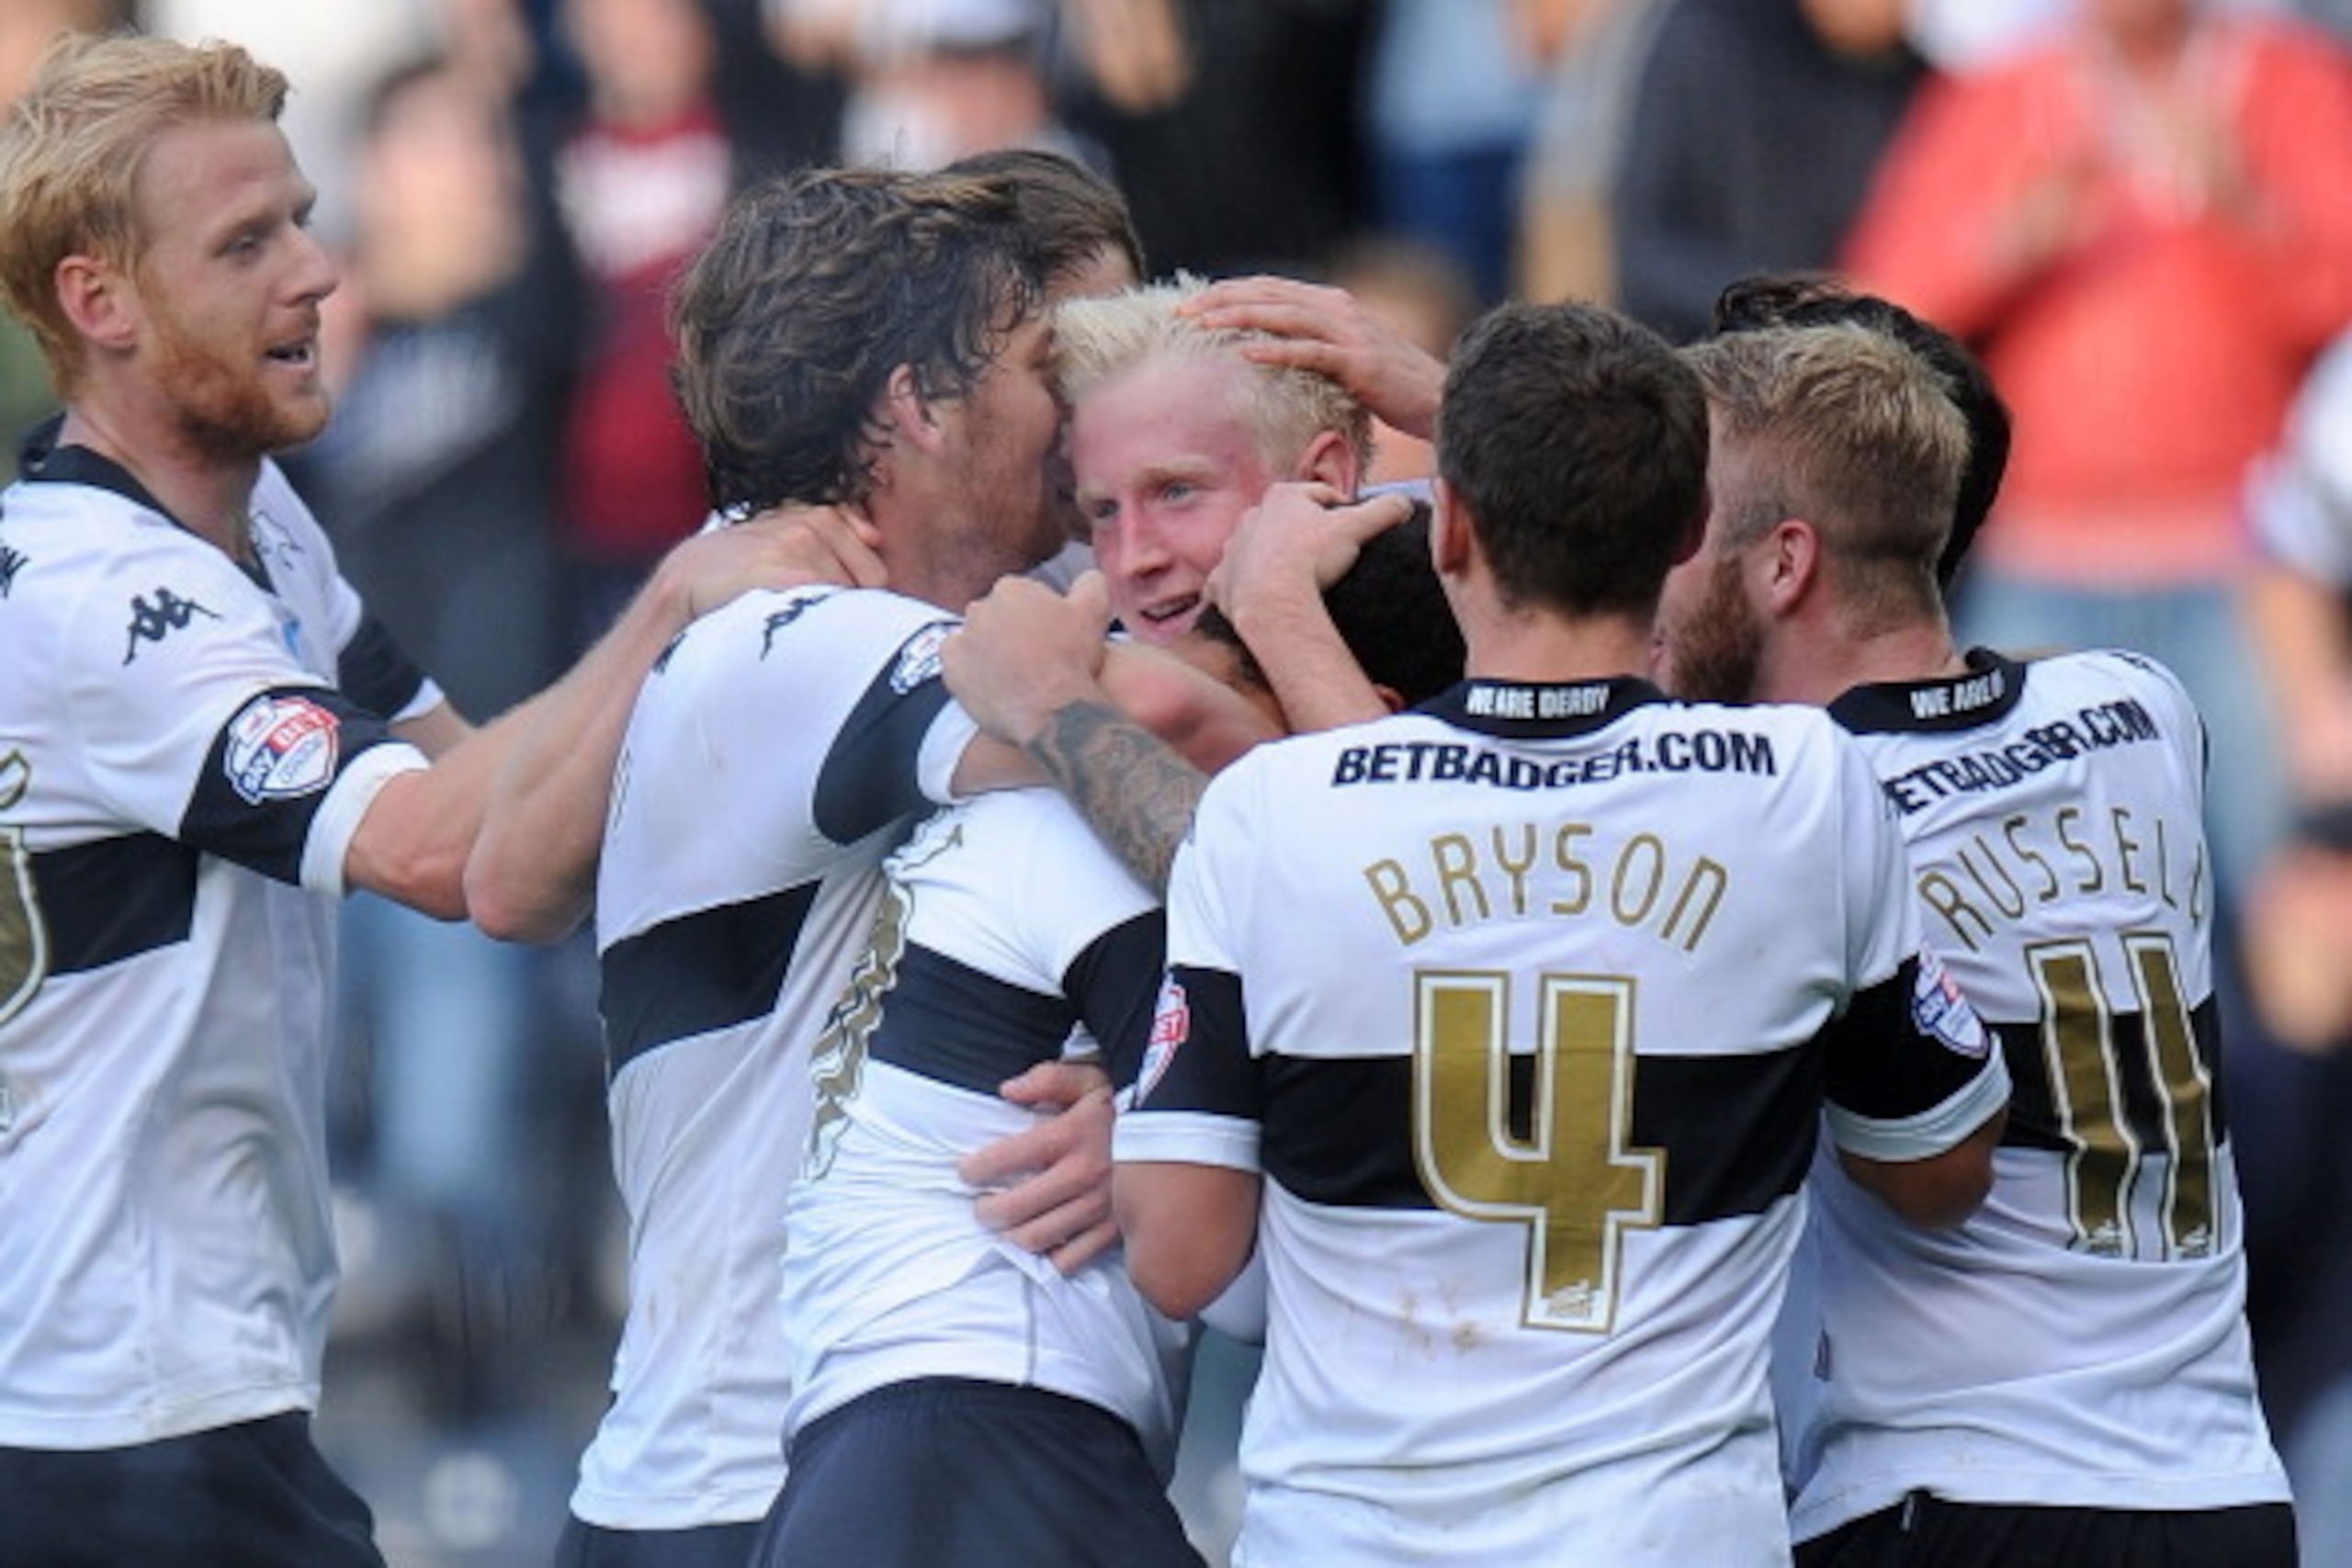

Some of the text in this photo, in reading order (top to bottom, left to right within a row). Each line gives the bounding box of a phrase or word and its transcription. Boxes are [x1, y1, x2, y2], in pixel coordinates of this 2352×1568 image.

[1331, 730, 1777, 791] BETBADGER.COM
[1910, 685, 1951, 719] WE
[1362, 823, 1728, 953] BRYSON
[1413, 969, 1669, 1335] 4
[2023, 931, 2222, 1262] 11
